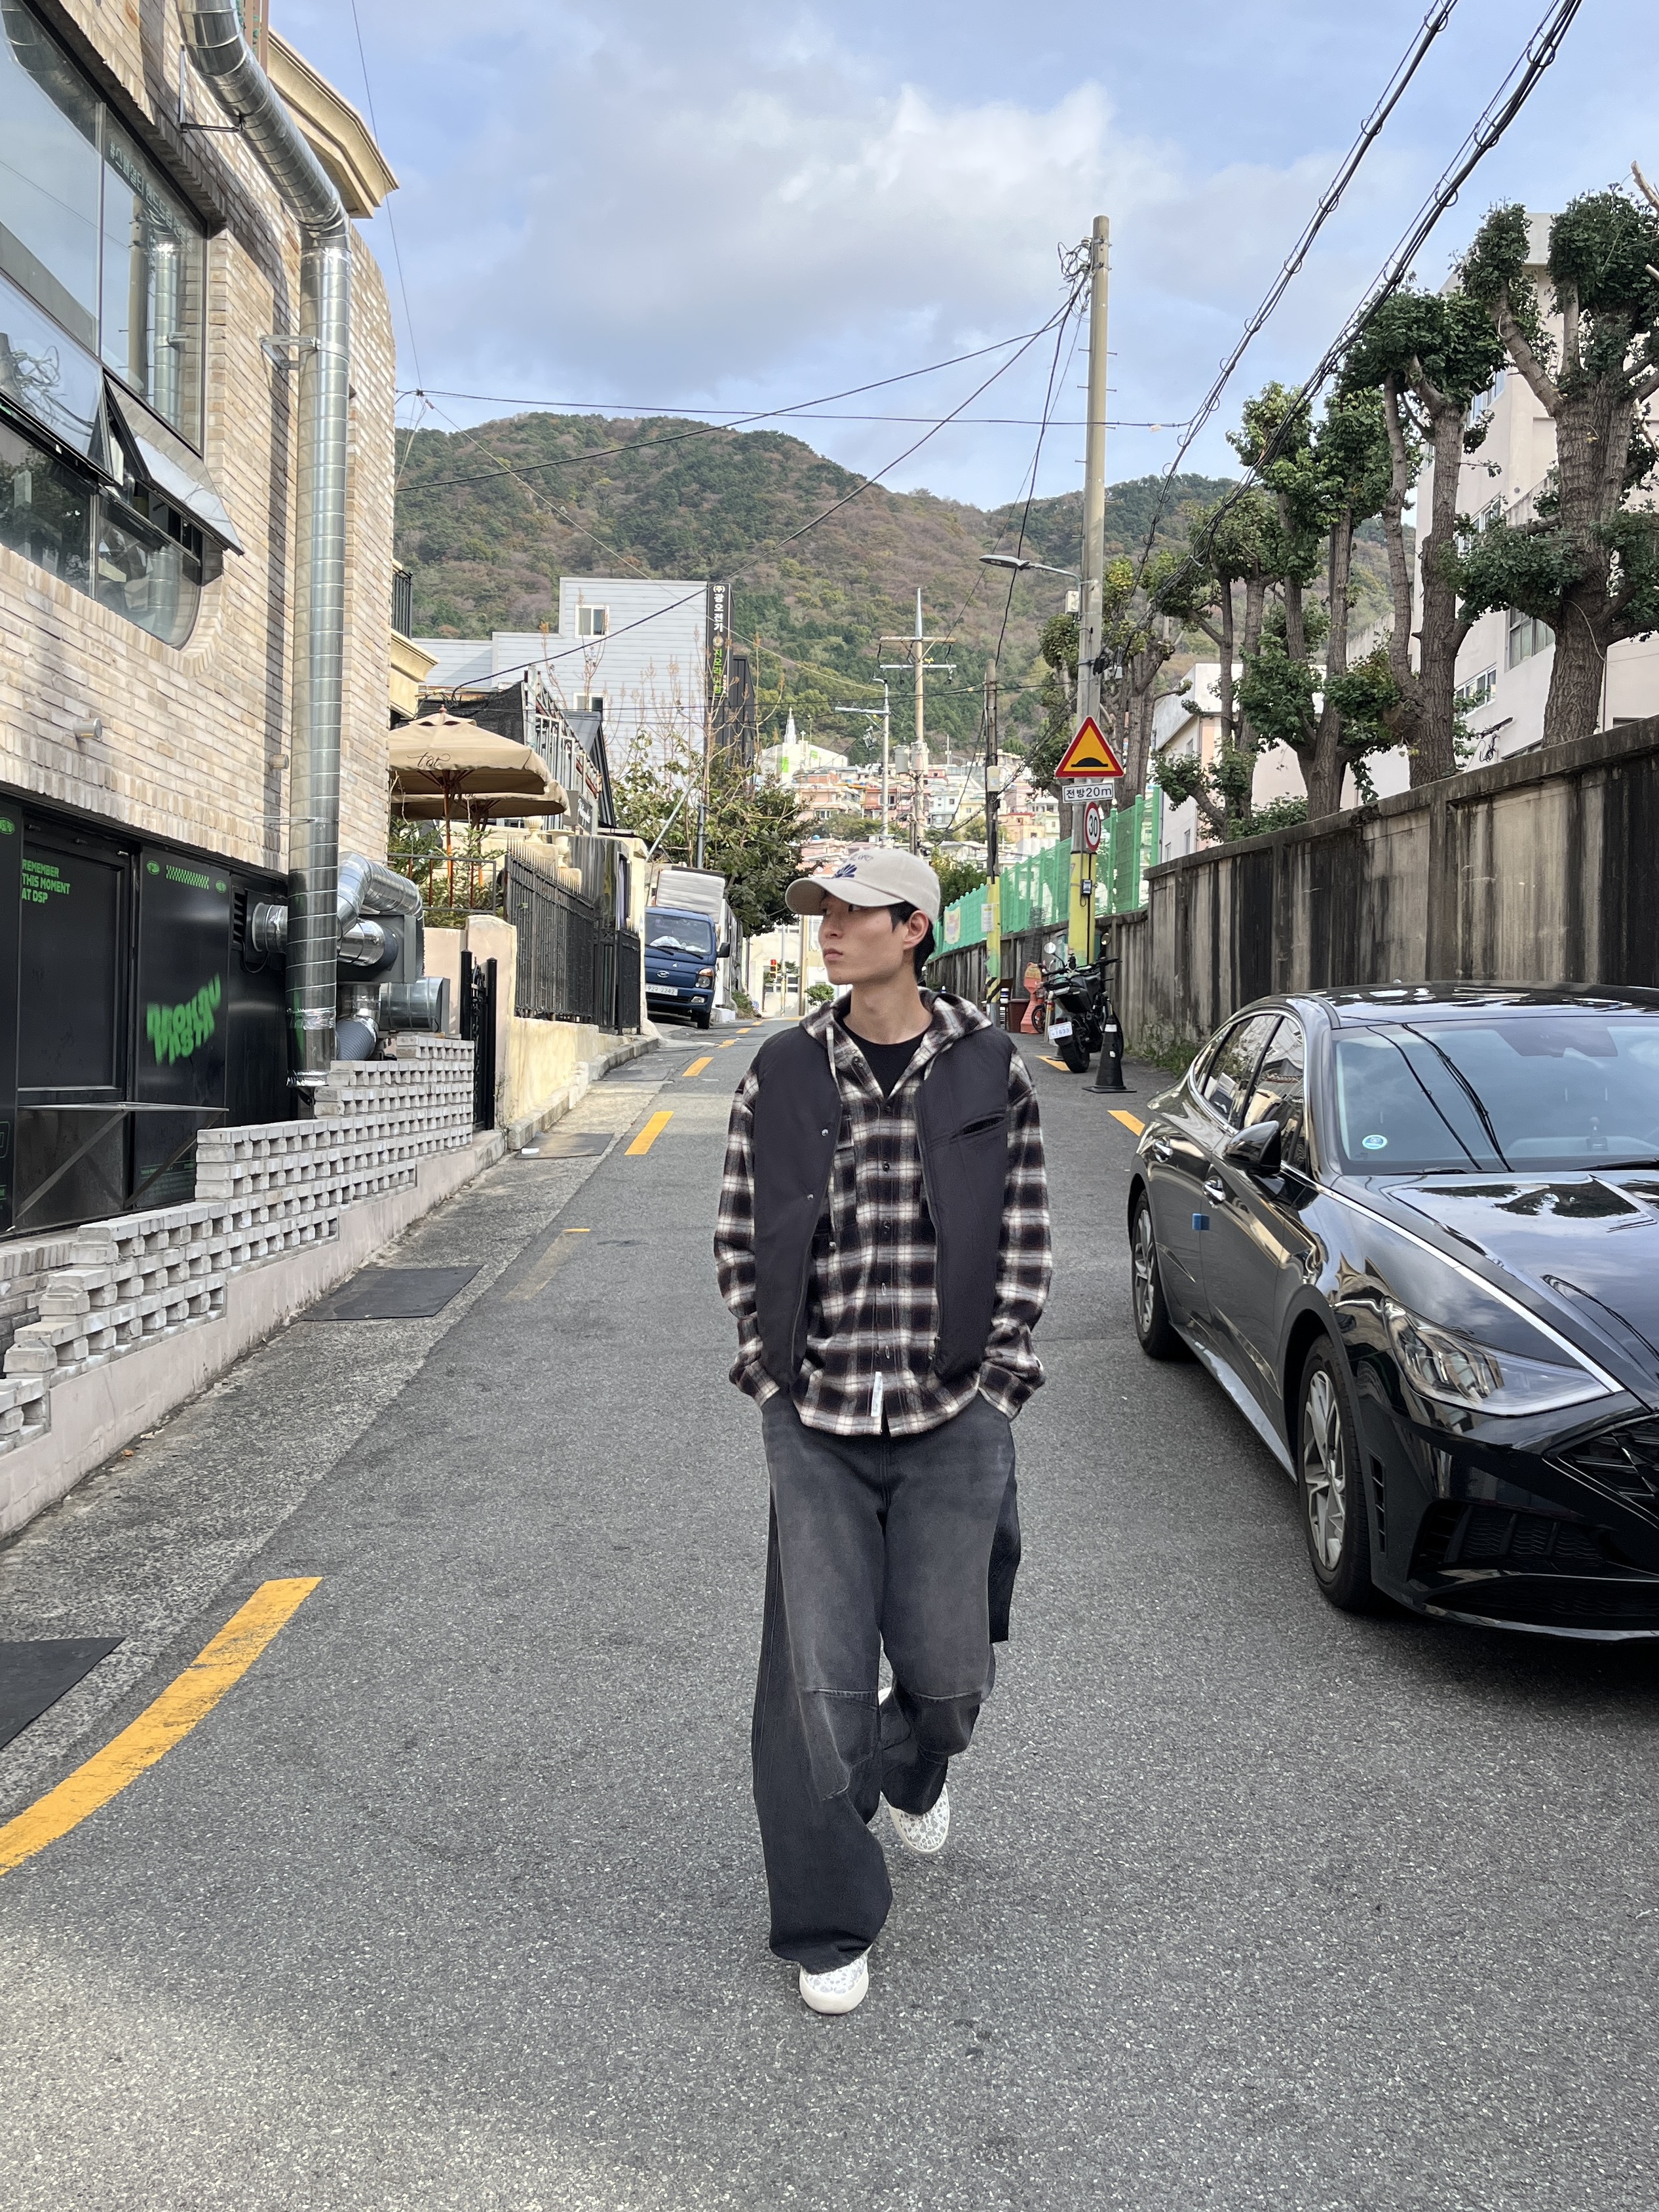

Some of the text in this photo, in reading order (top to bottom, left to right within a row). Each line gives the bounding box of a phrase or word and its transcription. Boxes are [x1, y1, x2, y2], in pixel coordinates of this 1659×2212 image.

[110, 141, 143, 195] #스페셜티
[1066, 787, 1111, 798] 전방20m
[1089, 815, 1098, 838] 30
[22, 859, 59, 878] REMEMBER
[22, 872, 70, 895] THIS MOMENT
[21, 887, 48, 904] AT DSP
